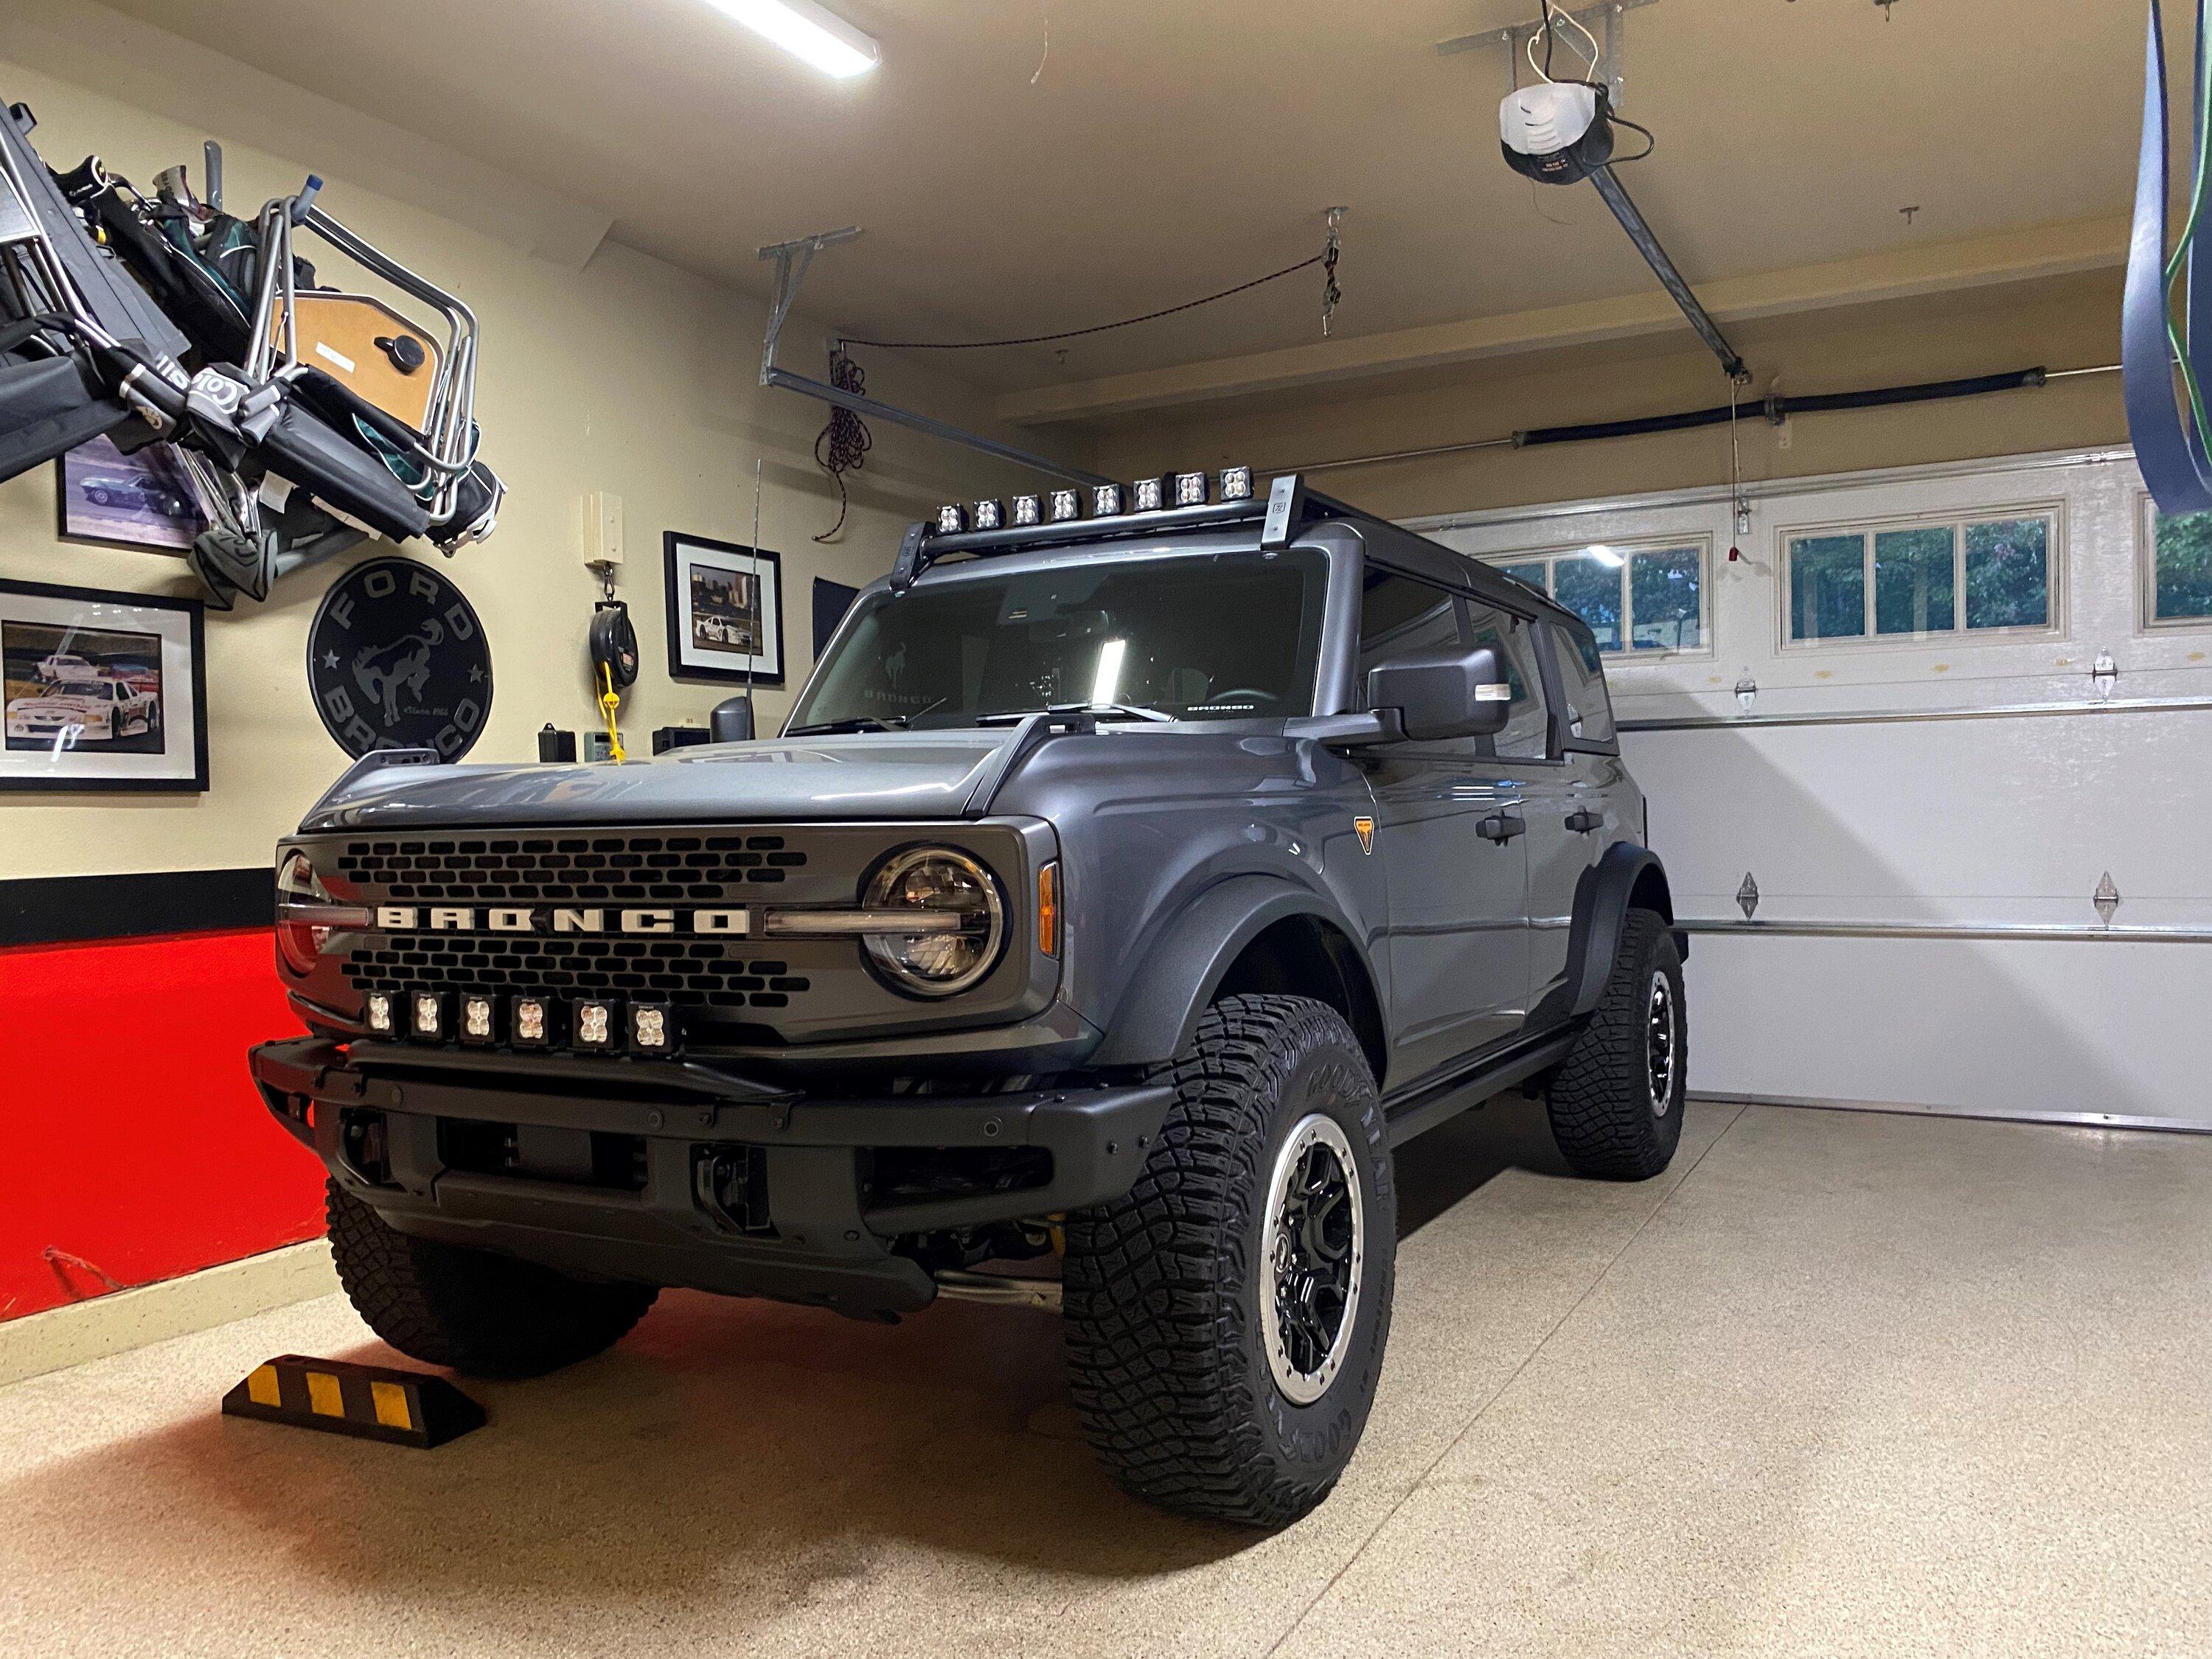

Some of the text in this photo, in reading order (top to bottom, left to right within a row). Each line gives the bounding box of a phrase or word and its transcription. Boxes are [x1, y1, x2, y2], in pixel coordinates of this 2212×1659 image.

[330, 569, 473, 641] FORD
[323, 684, 480, 757] BRCO
[377, 906, 751, 934] BRONCO
